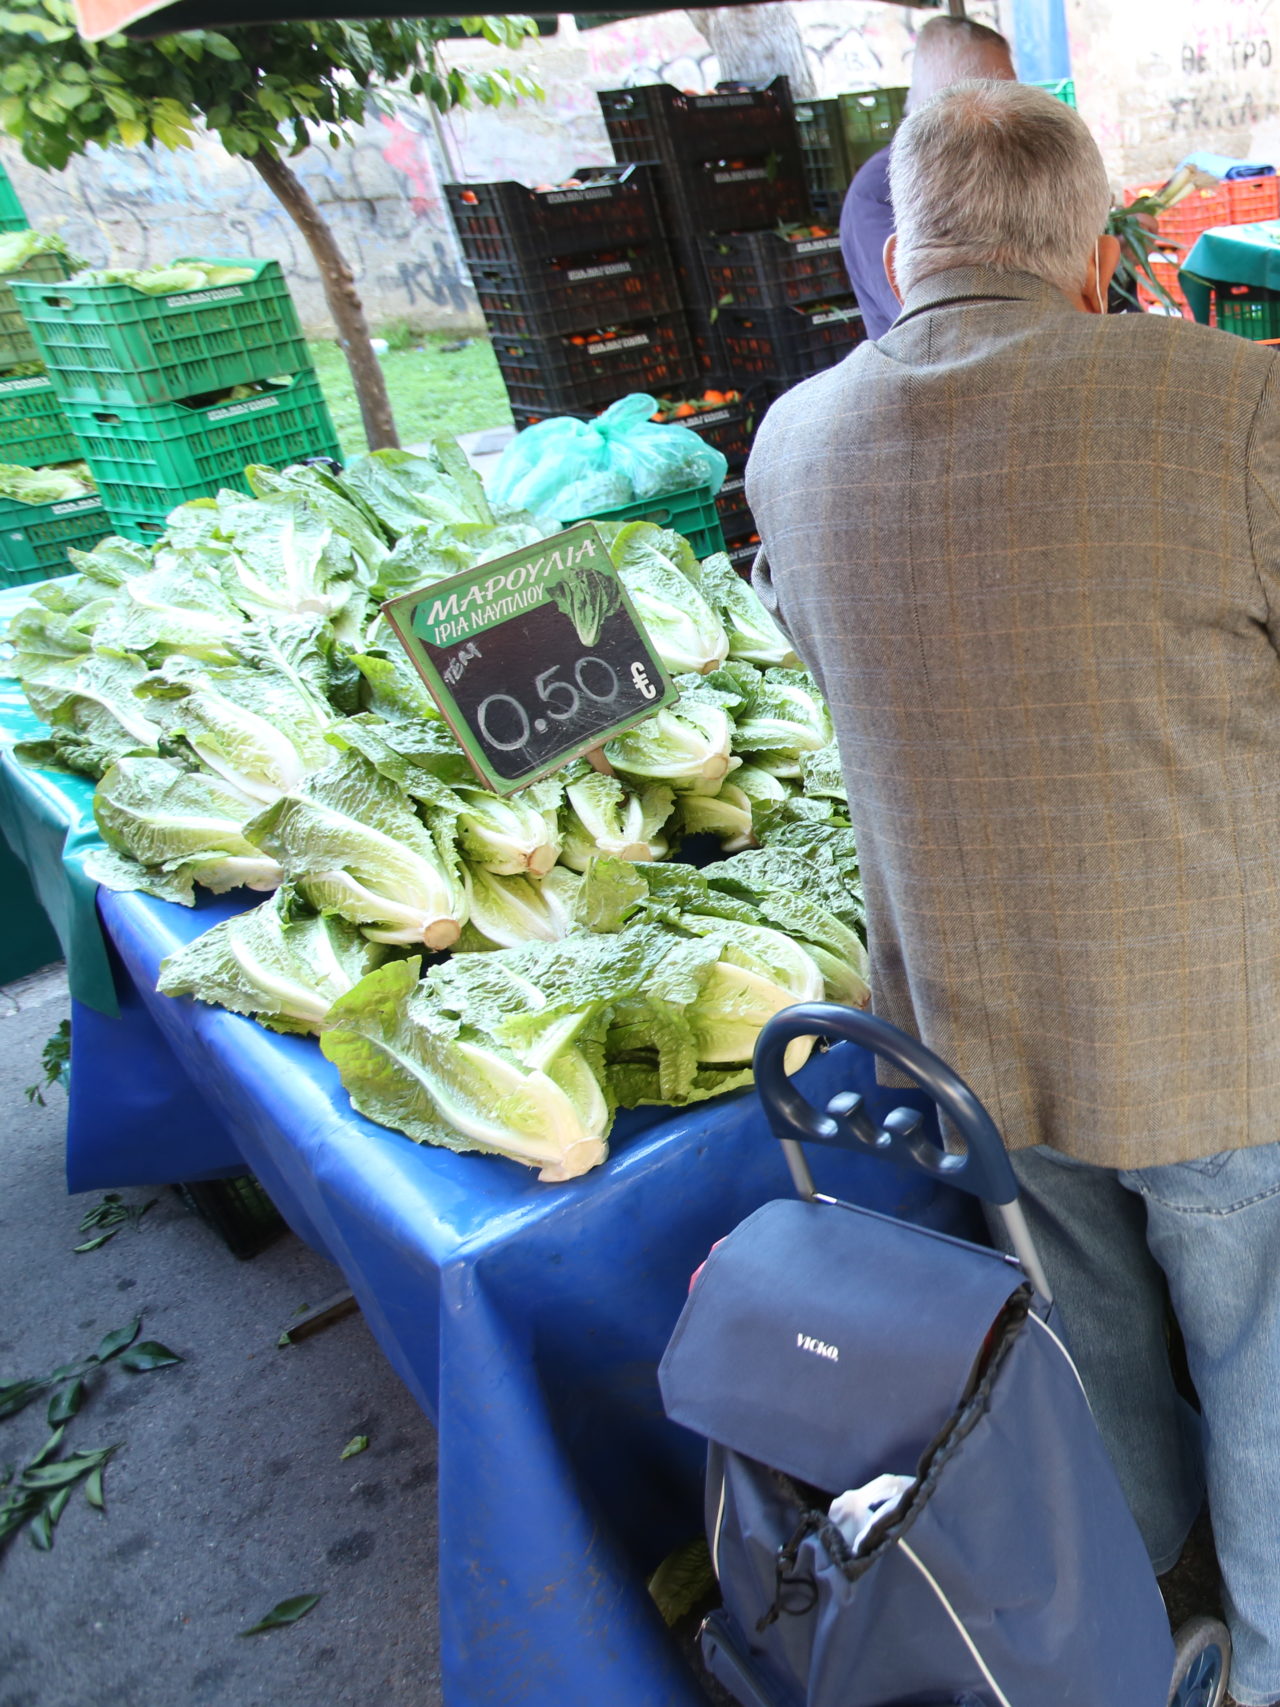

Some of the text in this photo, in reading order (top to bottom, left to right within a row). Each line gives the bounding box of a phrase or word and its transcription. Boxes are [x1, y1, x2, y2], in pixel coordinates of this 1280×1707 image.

[427, 539, 597, 626] ΜΑΡΟΥΛΙΑ
[434, 583, 545, 645] ΙΡΙΑ ΝΑΥΠΛΙΟΥ
[477, 657, 657, 751] 0.50 €
